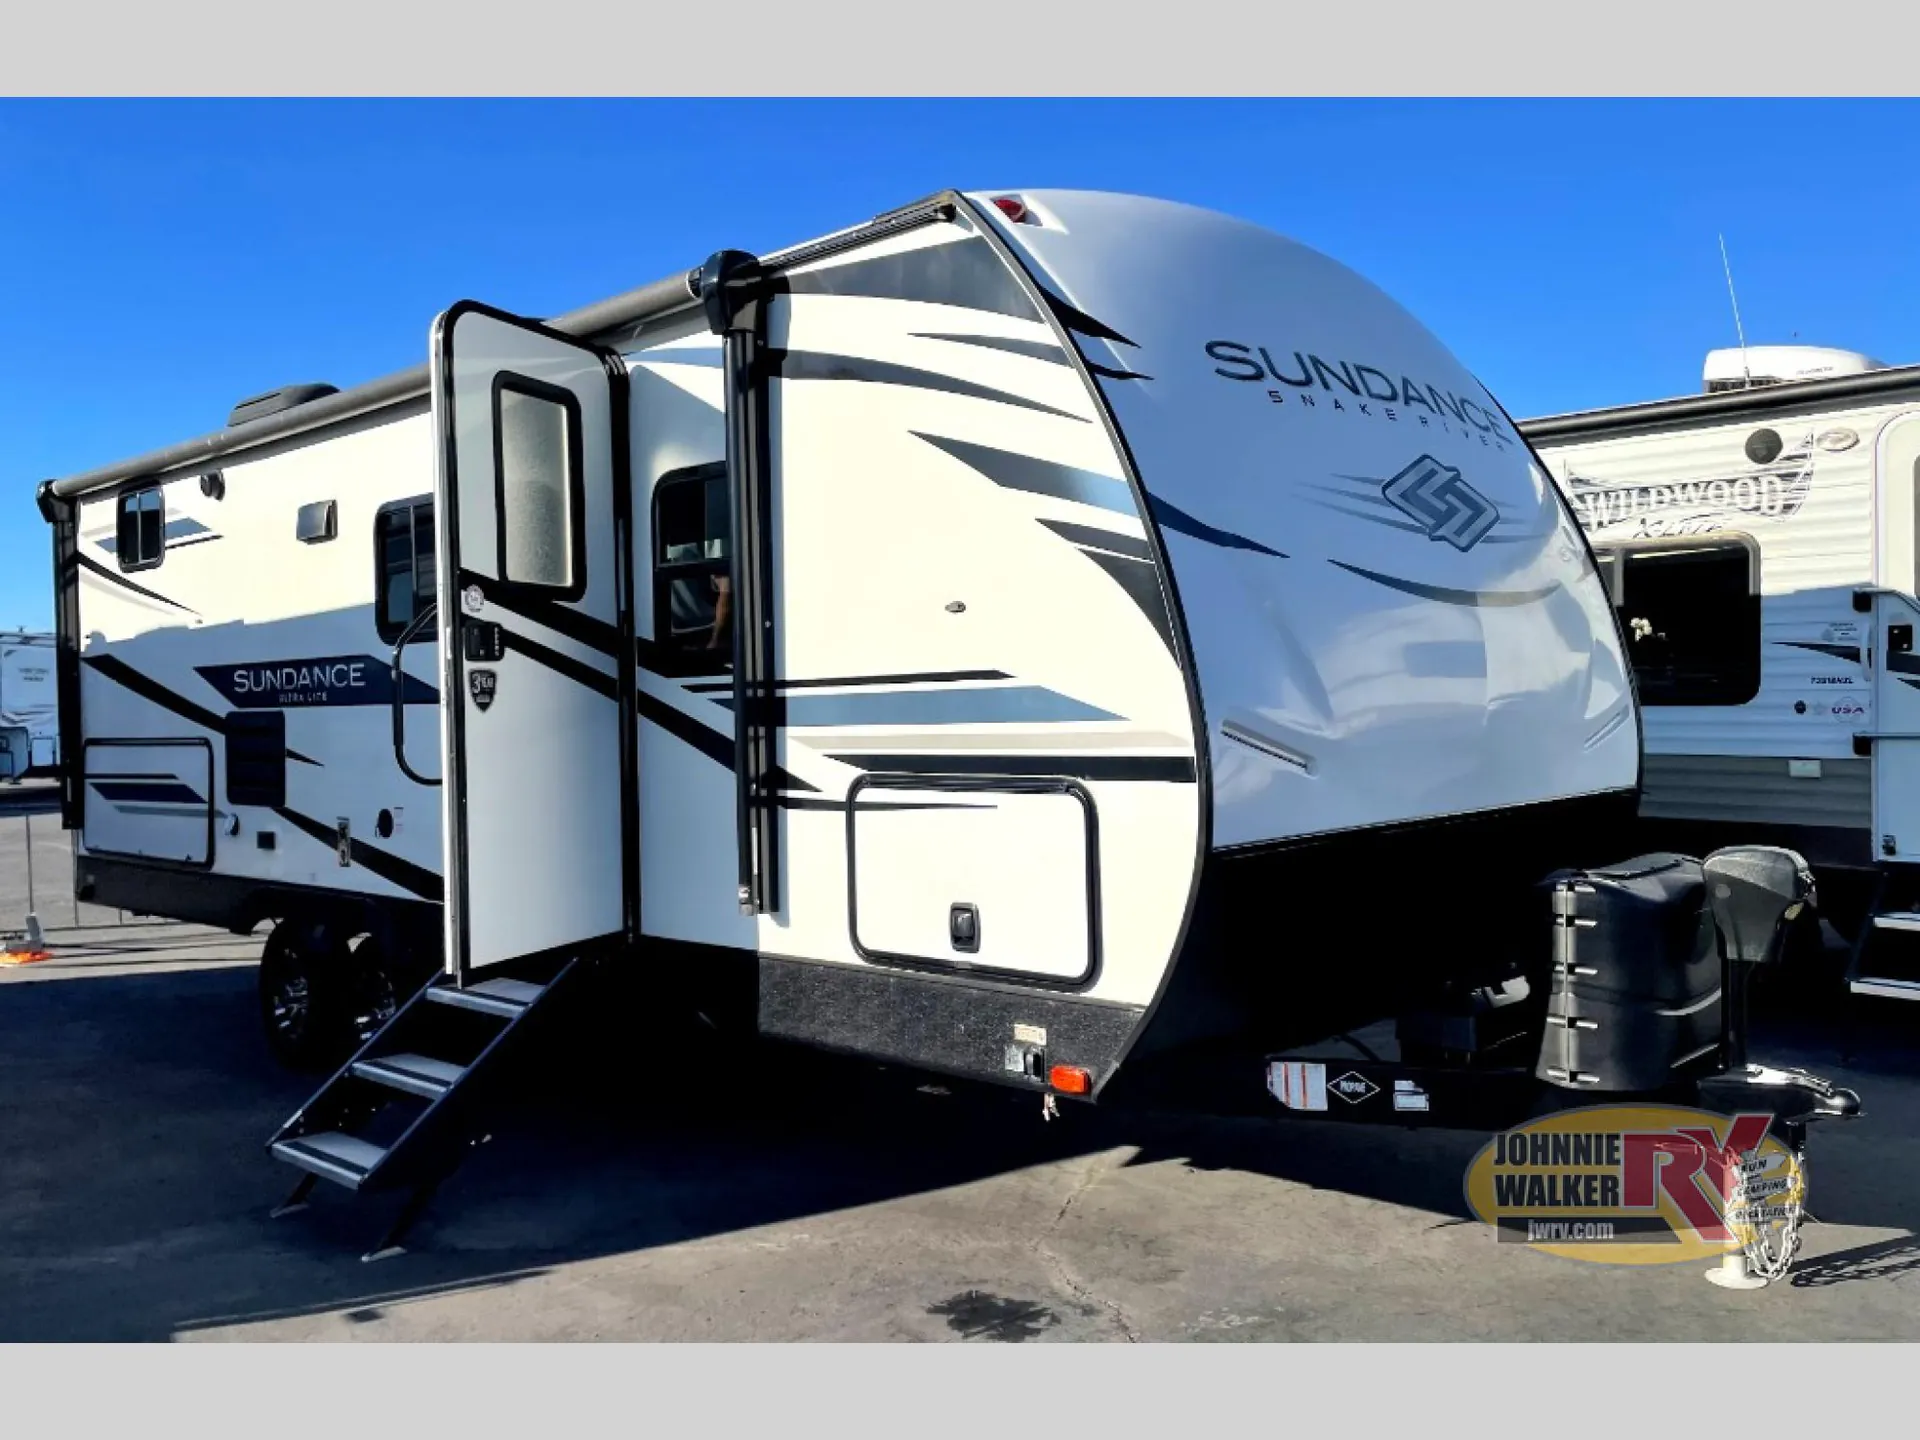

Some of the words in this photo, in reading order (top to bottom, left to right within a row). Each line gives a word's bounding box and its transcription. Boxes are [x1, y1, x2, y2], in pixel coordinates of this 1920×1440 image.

[1205, 340, 1513, 445] SUNDANCE
[1267, 389, 1398, 422] SNAKE
[1570, 474, 1788, 533] WILDWOOD
[233, 663, 366, 693] SUNDANCE
[1831, 706, 1865, 715] USA
